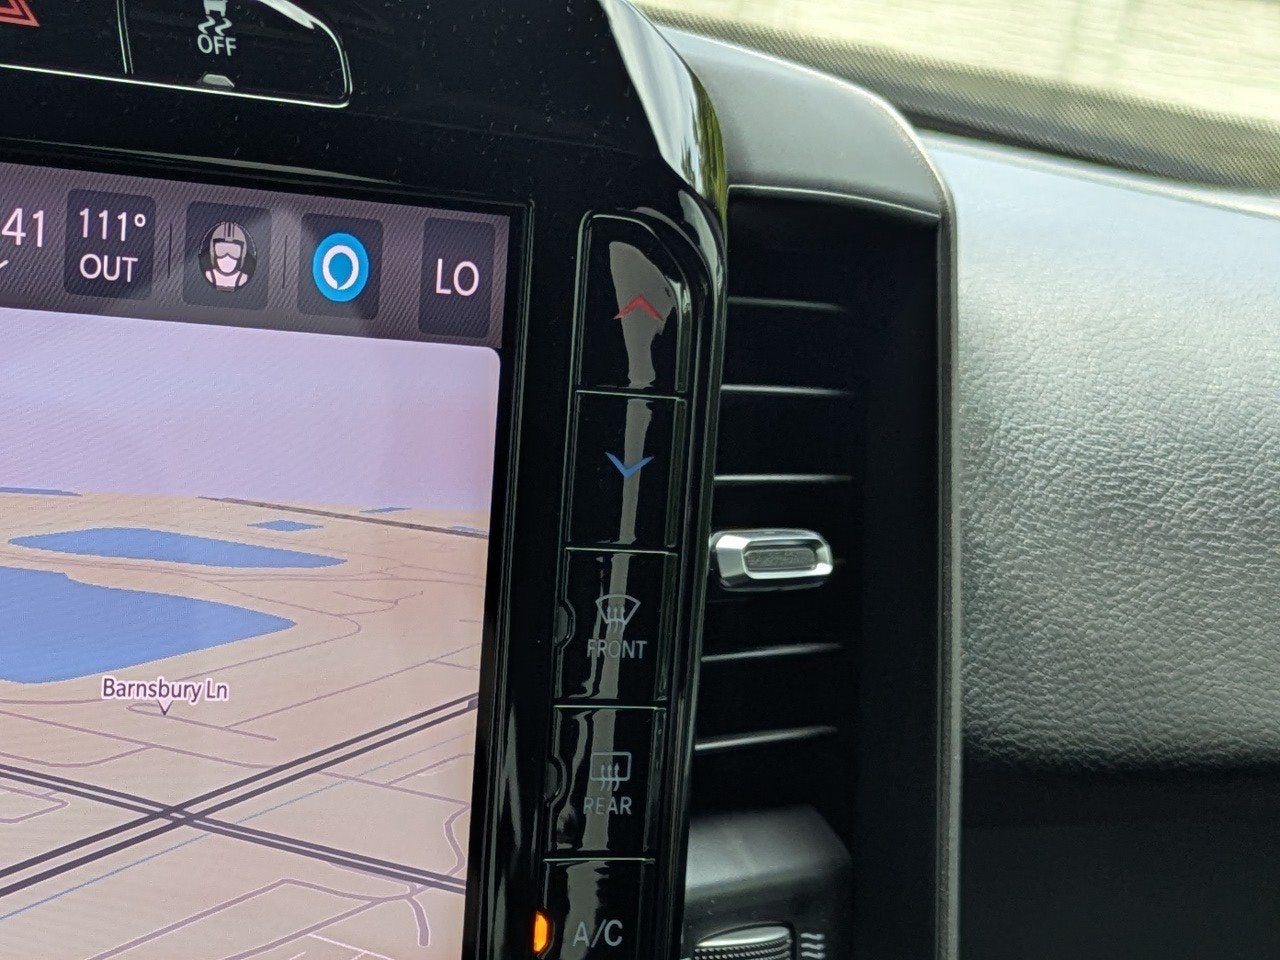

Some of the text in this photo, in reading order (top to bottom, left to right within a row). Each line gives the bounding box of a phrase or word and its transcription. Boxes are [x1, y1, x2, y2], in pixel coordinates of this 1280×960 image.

[197, 33, 237, 58] OFF
[78, 207, 147, 243] 111°
[79, 252, 139, 284] OUT
[434, 257, 480, 298] LO
[586, 640, 648, 660] FRONT
[102, 677, 228, 703] Barnsbury Ln
[582, 797, 633, 816] REAR
[571, 919, 624, 948] A/C
